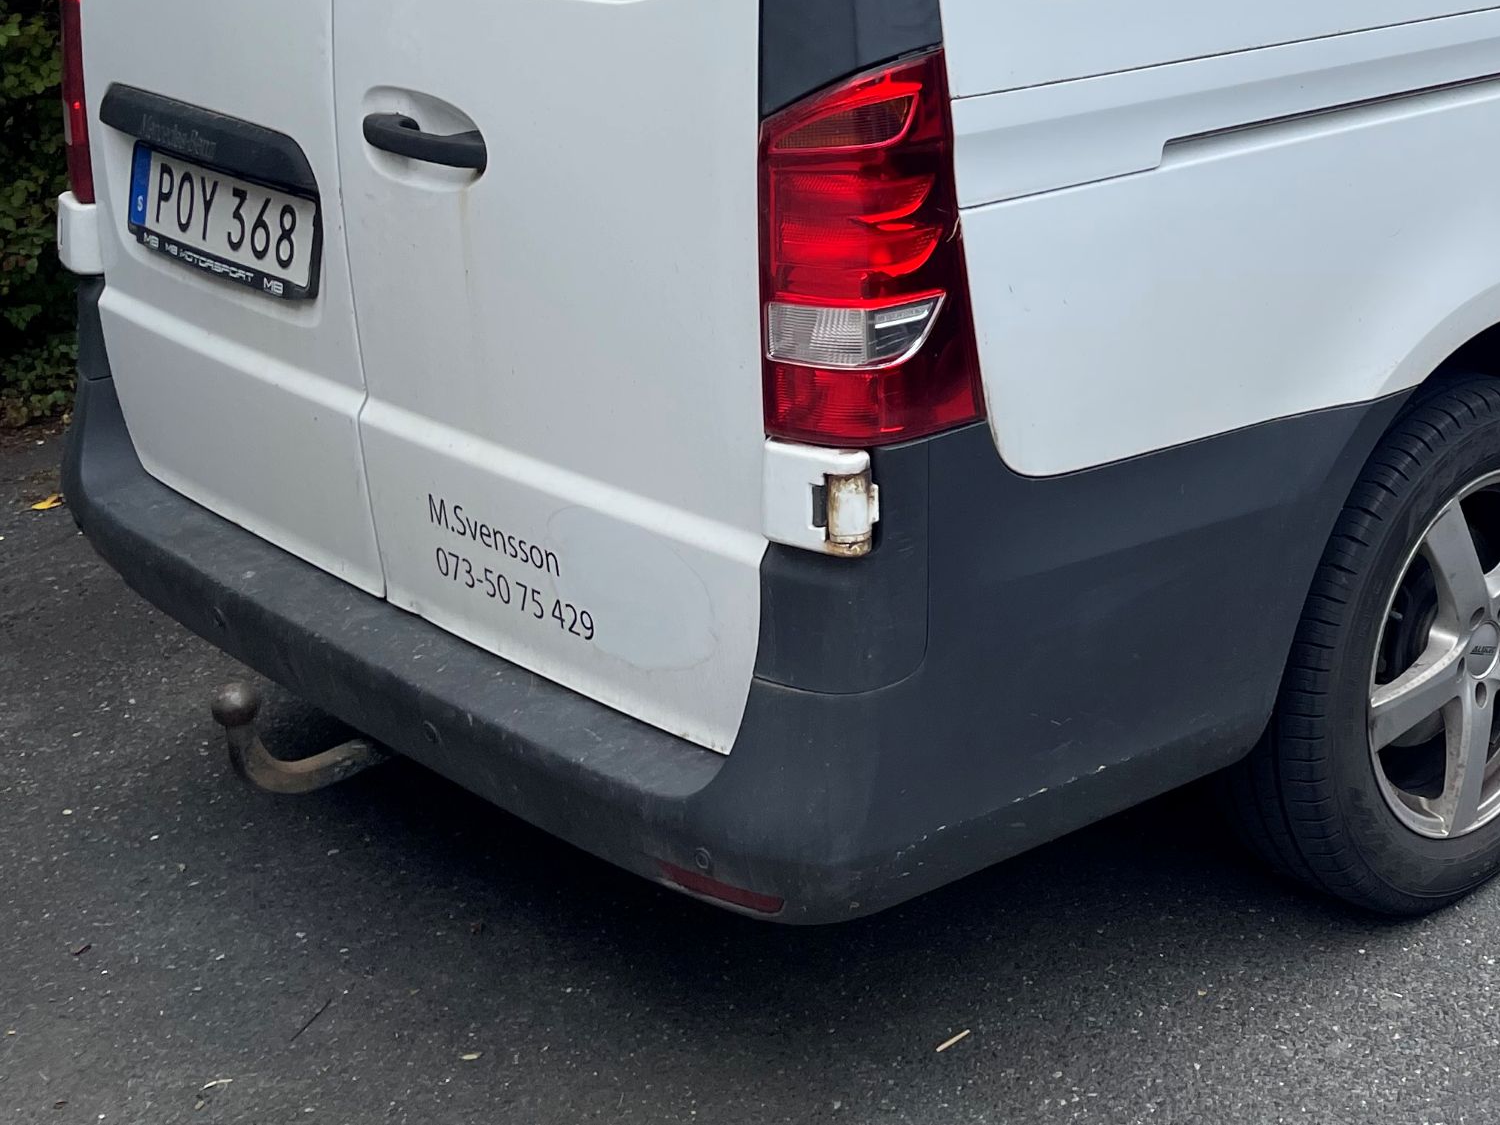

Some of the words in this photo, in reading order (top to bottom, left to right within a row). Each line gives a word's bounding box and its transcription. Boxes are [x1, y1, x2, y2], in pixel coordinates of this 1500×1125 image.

[155, 162, 219, 242] POY
[226, 186, 297, 269] 368
[428, 493, 561, 577] M.Svensson
[435, 547, 511, 605] 073-50
[515, 581, 544, 620] 75
[551, 599, 595, 641] 429
